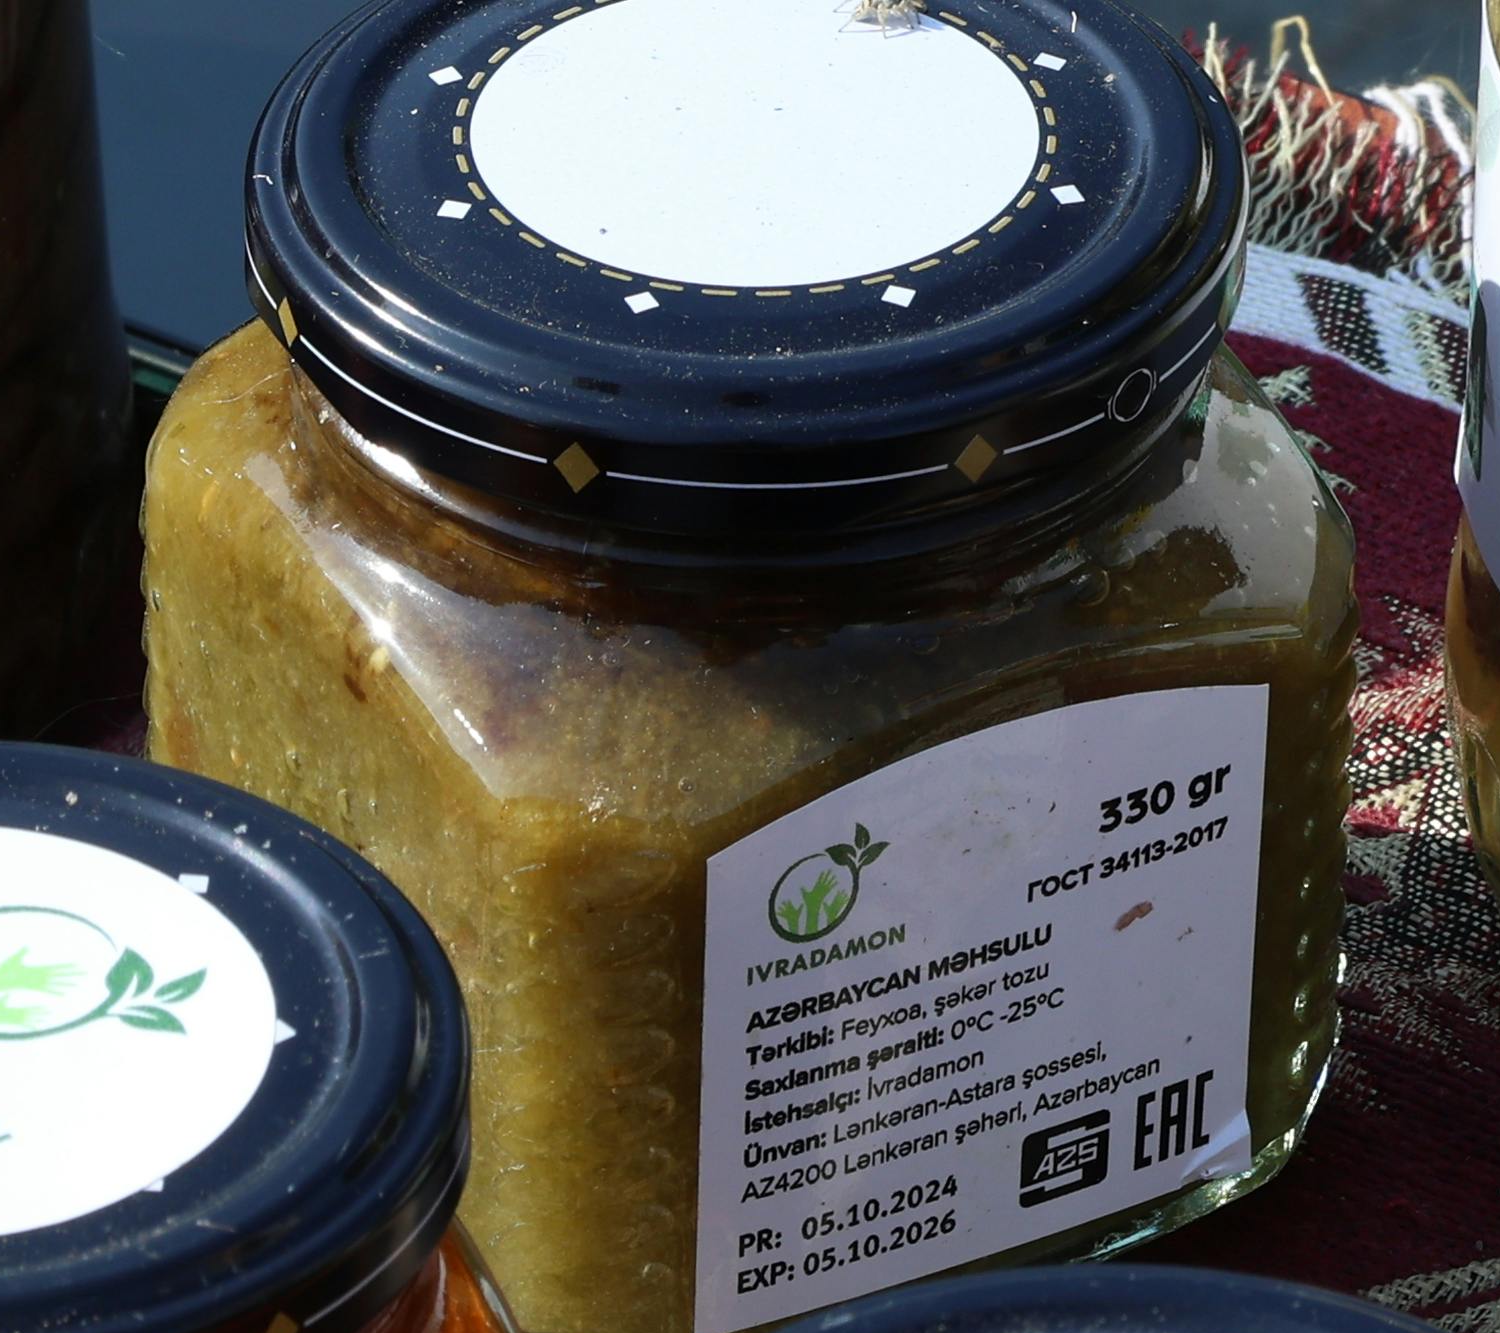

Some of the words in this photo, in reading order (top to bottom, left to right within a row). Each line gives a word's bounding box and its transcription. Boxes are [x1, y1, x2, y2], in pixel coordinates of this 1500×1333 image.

[1098, 780, 1176, 833] 330
[1188, 764, 1231, 808] gr
[1027, 863, 1095, 903] ГОСТ
[1099, 815, 1229, 879] 34113-2017
[746, 924, 907, 986] IVRADAMON
[746, 965, 920, 1034] AZƏRBAYCAN
[928, 923, 1053, 980] MƏHSULU
[746, 1026, 834, 1067] Tərkibi:
[841, 1003, 928, 1043] Feyxoa,
[934, 980, 997, 1016] şəkər
[1002, 962, 1050, 991] tozu
[743, 1131, 827, 1169] Ünvan:
[832, 1073, 1016, 1145] Lənkəran-Astara
[1021, 1041, 1108, 1089] şossesi,
[744, 1088, 861, 1135] İstehsalçı:
[866, 1049, 985, 1101] İvradamon
[745, 1054, 862, 1100] Saxlanma
[867, 1028, 945, 1071] şəraiti:
[740, 1158, 838, 1203] AZ4200
[842, 1127, 948, 1175] Lənkəran
[954, 1102, 1027, 1147] şəhəri,
[1032, 1057, 1162, 1117] Azərbaycan
[1133, 1069, 1215, 1171] EAC
[737, 1229, 784, 1258] PR:
[800, 1174, 960, 1241] 05.10.2024
[737, 1255, 796, 1295] EXP:
[802, 1208, 957, 1278] 05.10.2026
